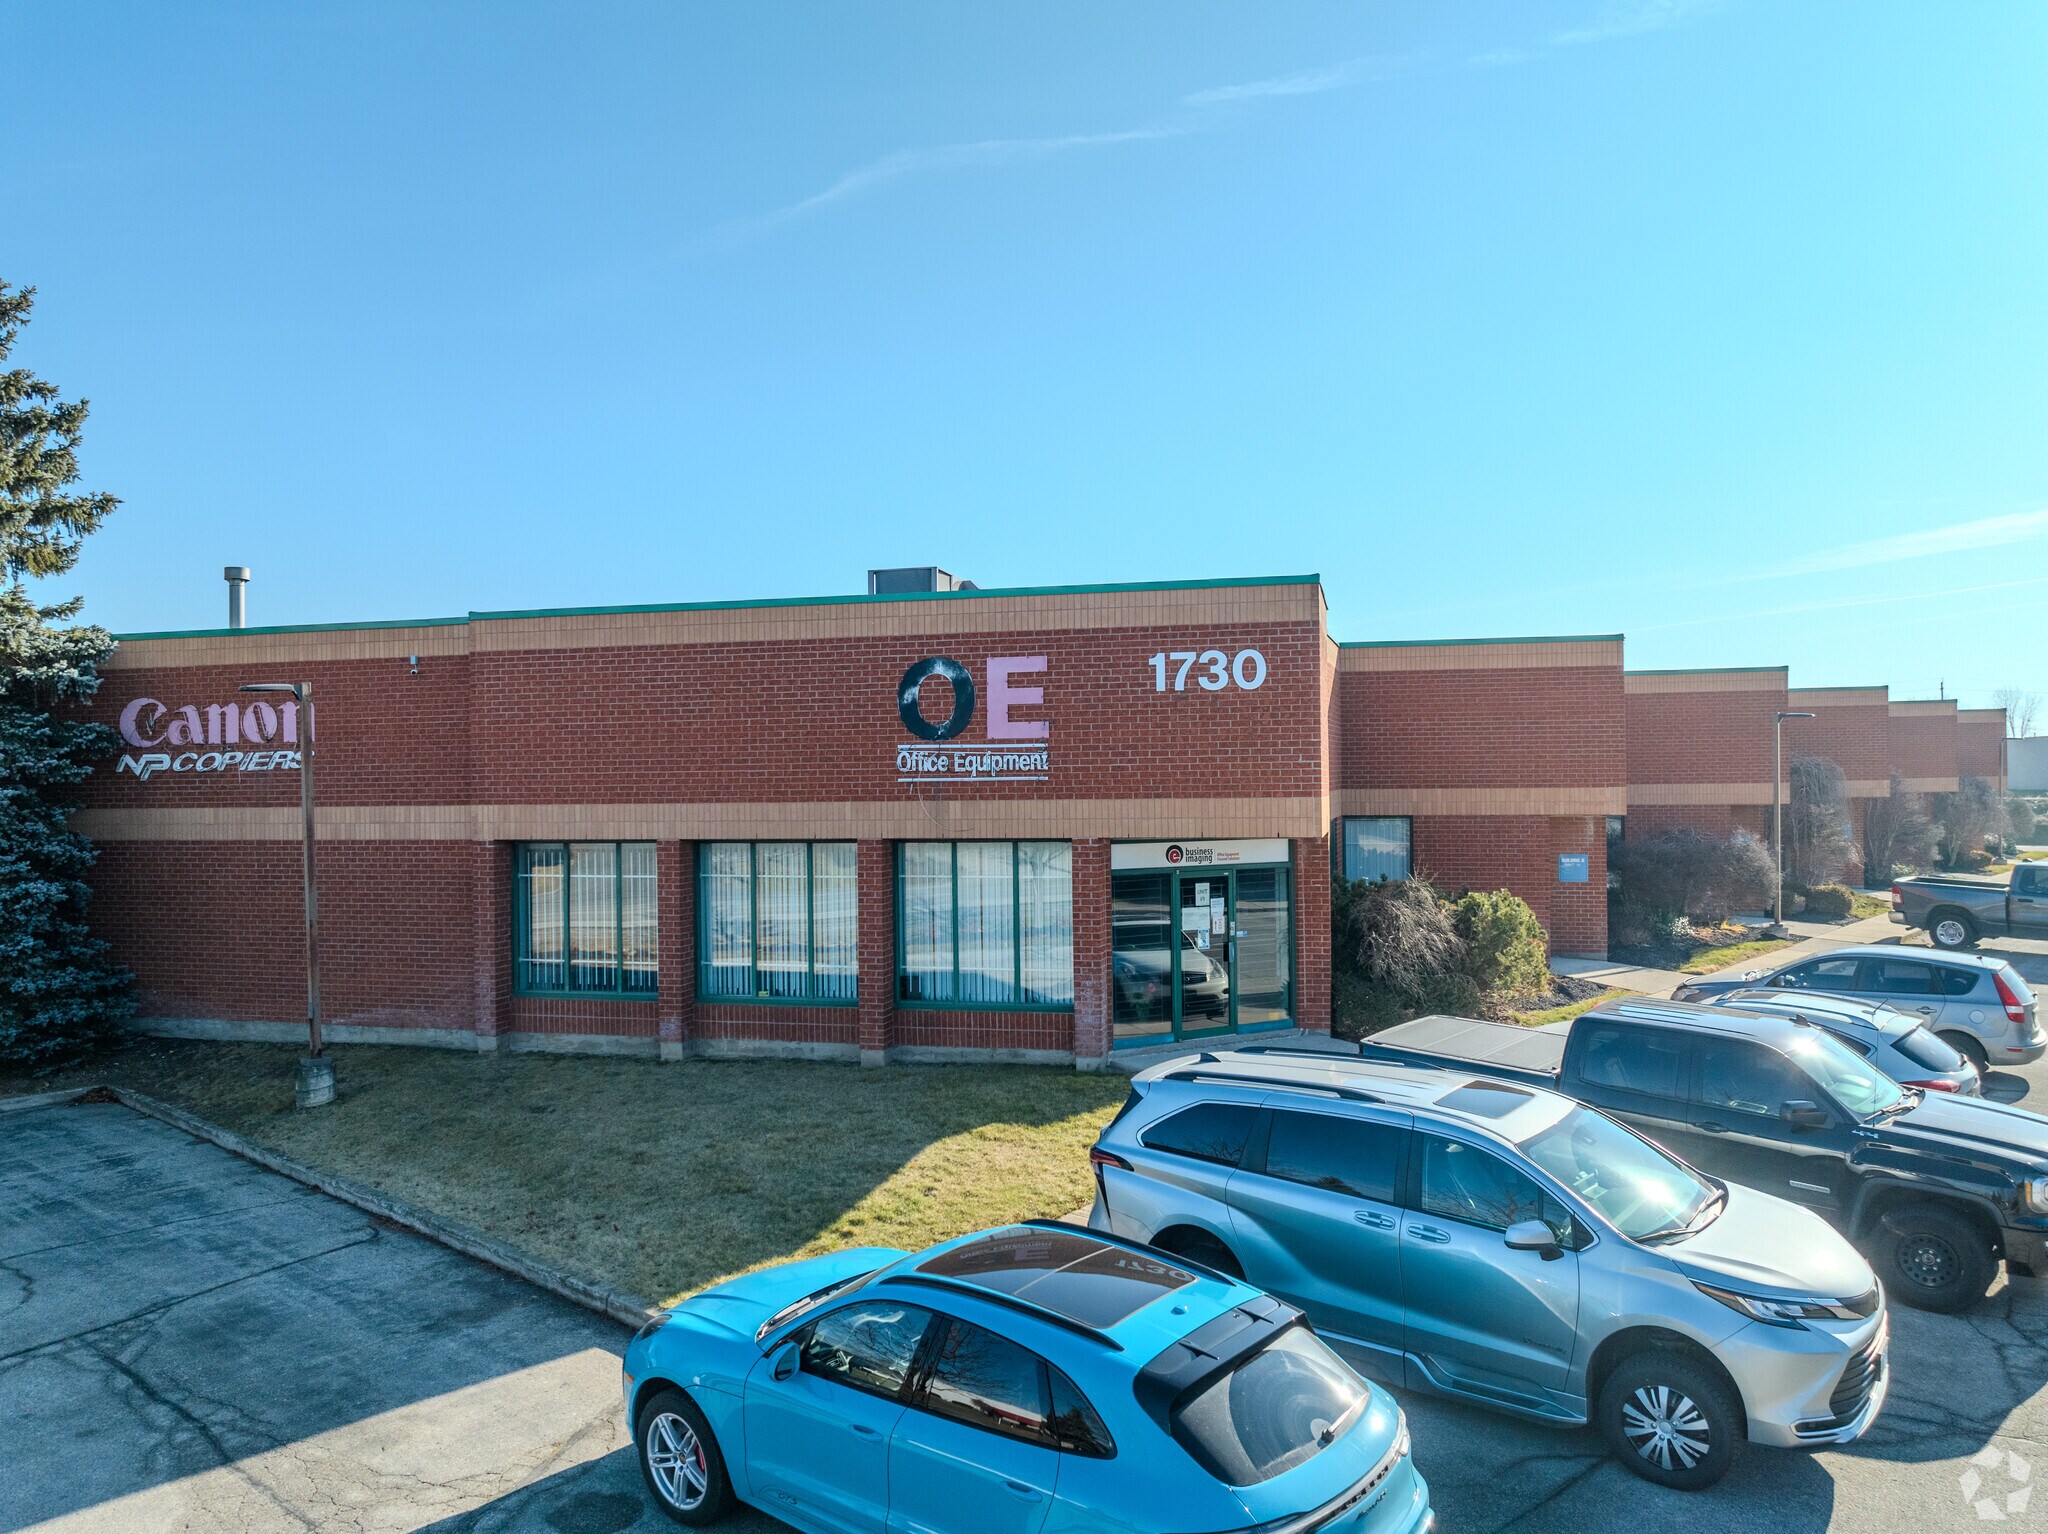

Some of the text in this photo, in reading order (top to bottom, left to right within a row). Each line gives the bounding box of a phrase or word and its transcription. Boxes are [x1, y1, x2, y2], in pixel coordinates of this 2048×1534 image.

[1148, 649, 1268, 692] 1730
[898, 655, 1050, 741] OE
[119, 697, 316, 748] Canon
[897, 750, 1049, 777] Office Equipment
[1185, 847, 1214, 856] business
[1185, 855, 1213, 864] imaging
